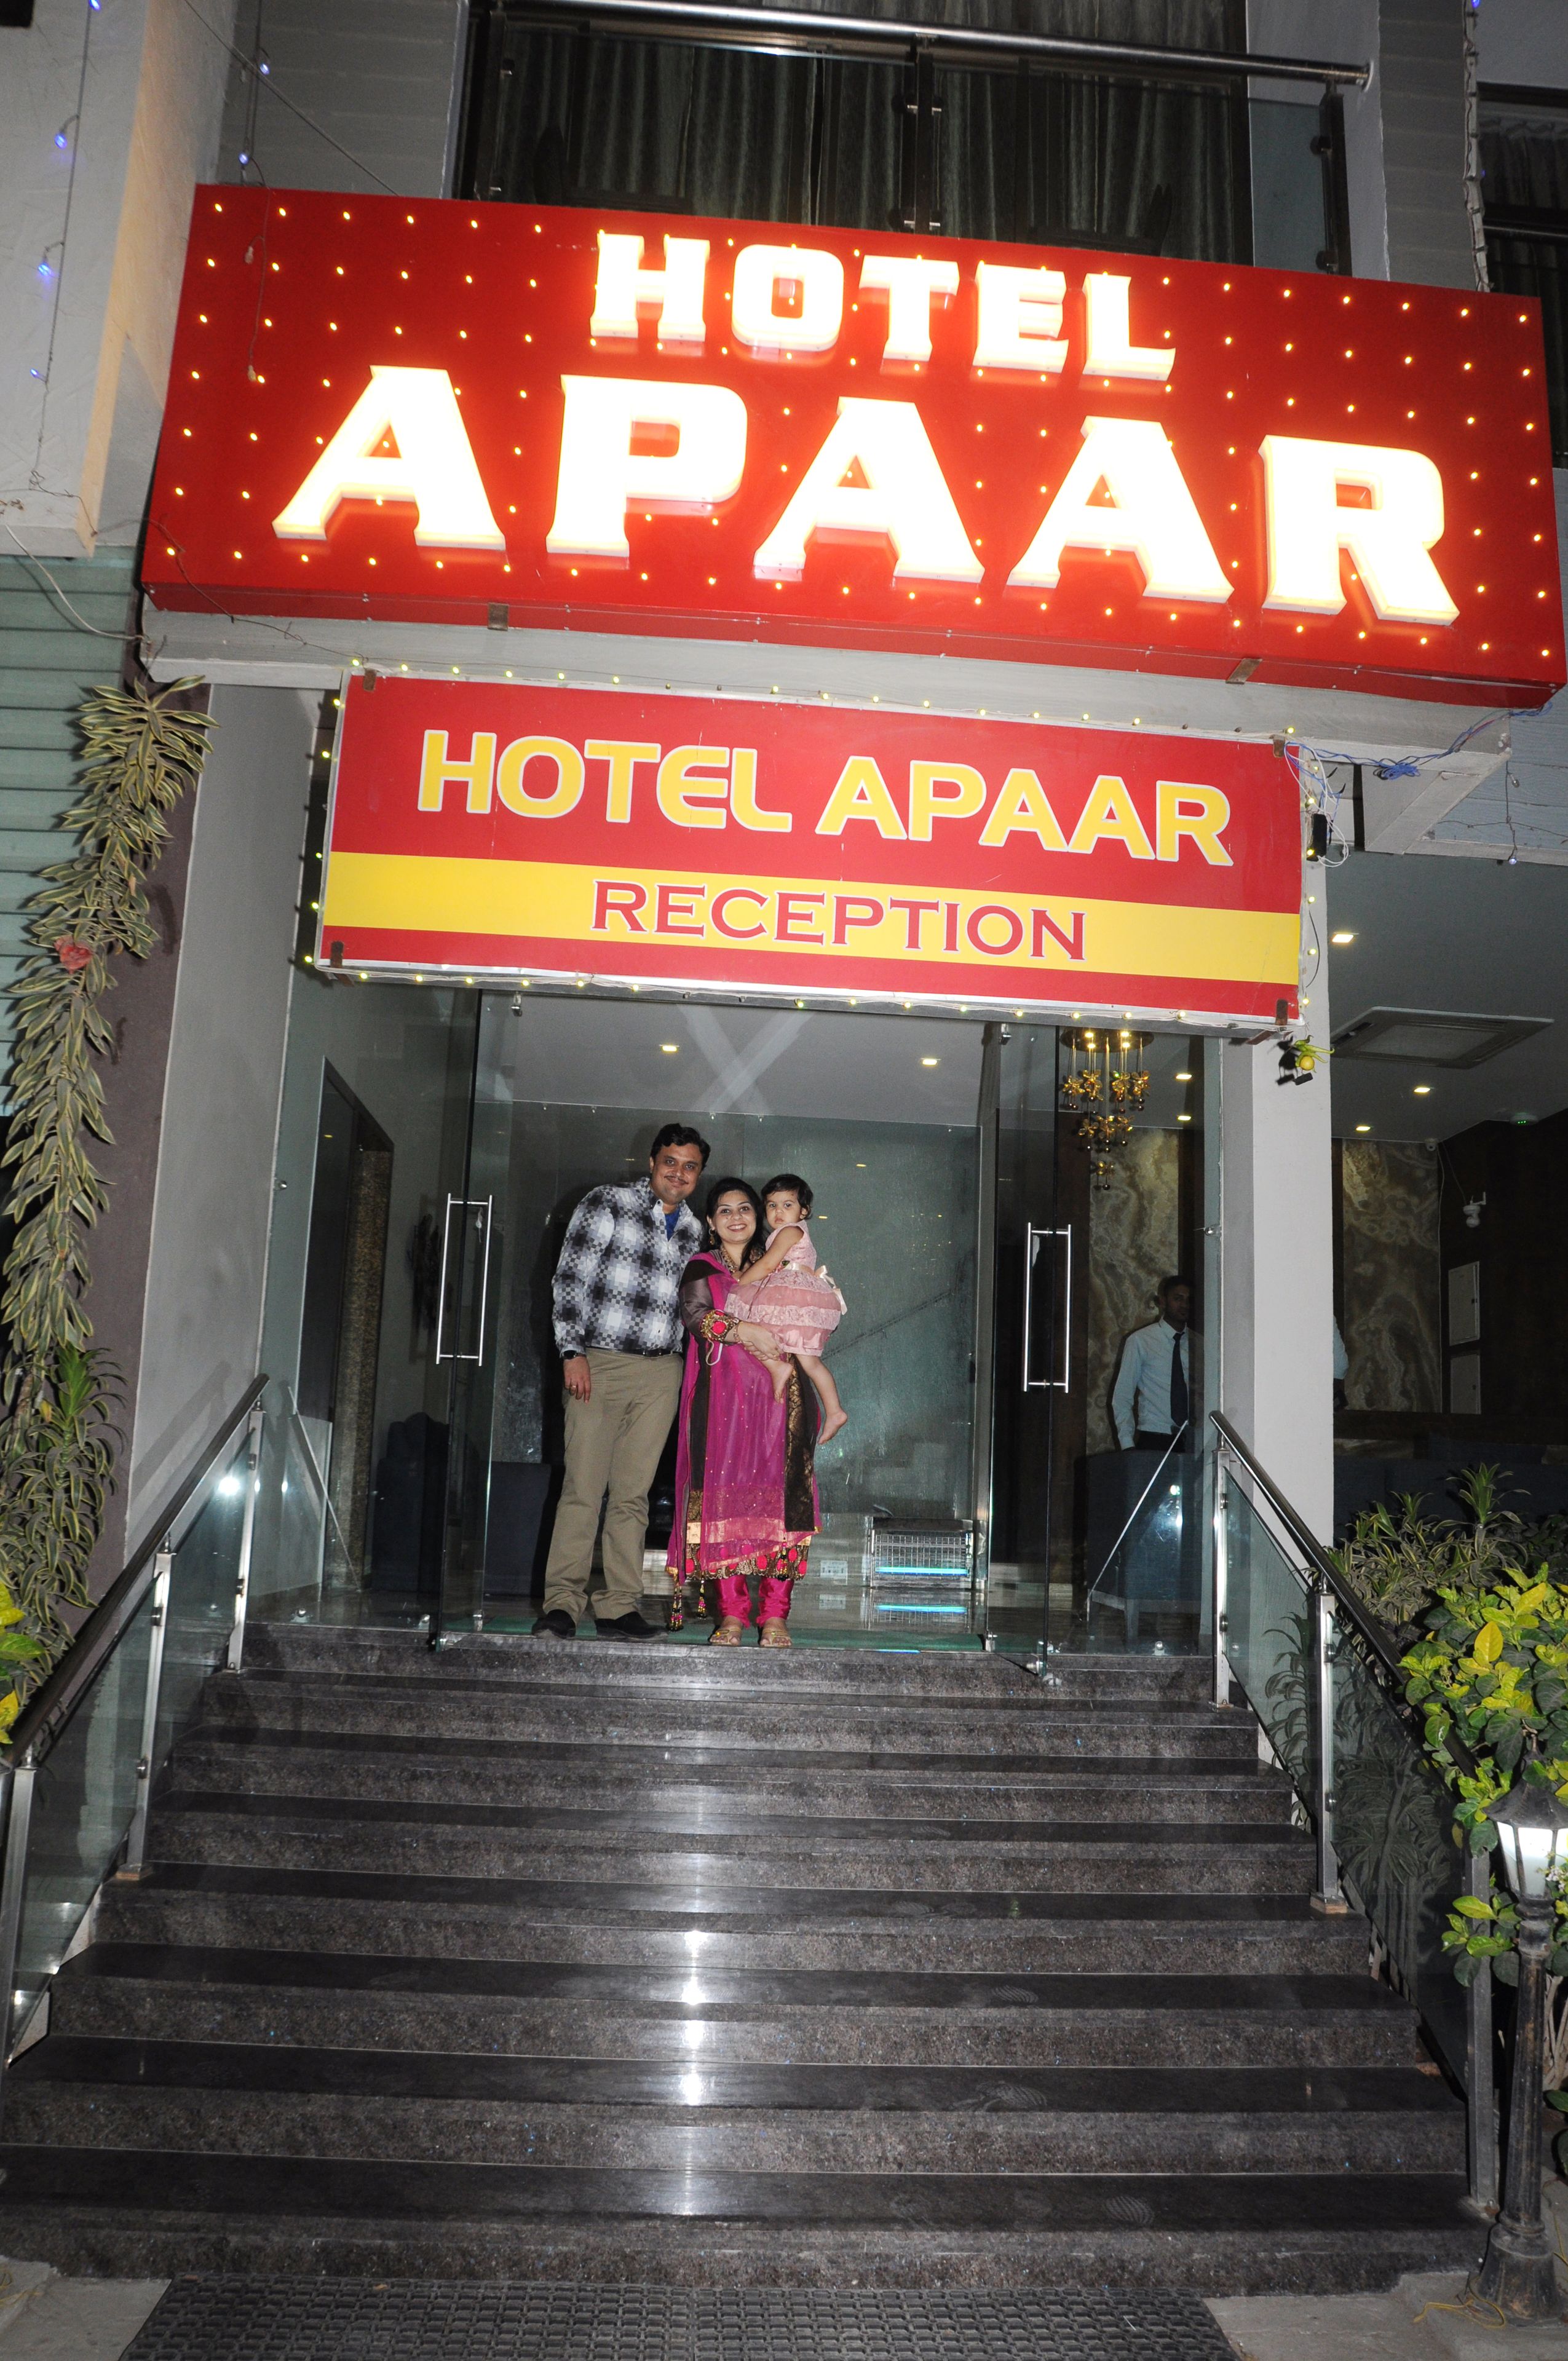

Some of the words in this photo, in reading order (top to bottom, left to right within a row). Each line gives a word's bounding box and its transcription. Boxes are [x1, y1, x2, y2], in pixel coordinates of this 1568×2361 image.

[589, 231, 1175, 382] HOTEL
[272, 365, 1460, 625] APAAR
[417, 729, 792, 833] HOTEL
[815, 755, 1233, 868] APAAR
[591, 879, 1087, 962] RECEPTION
